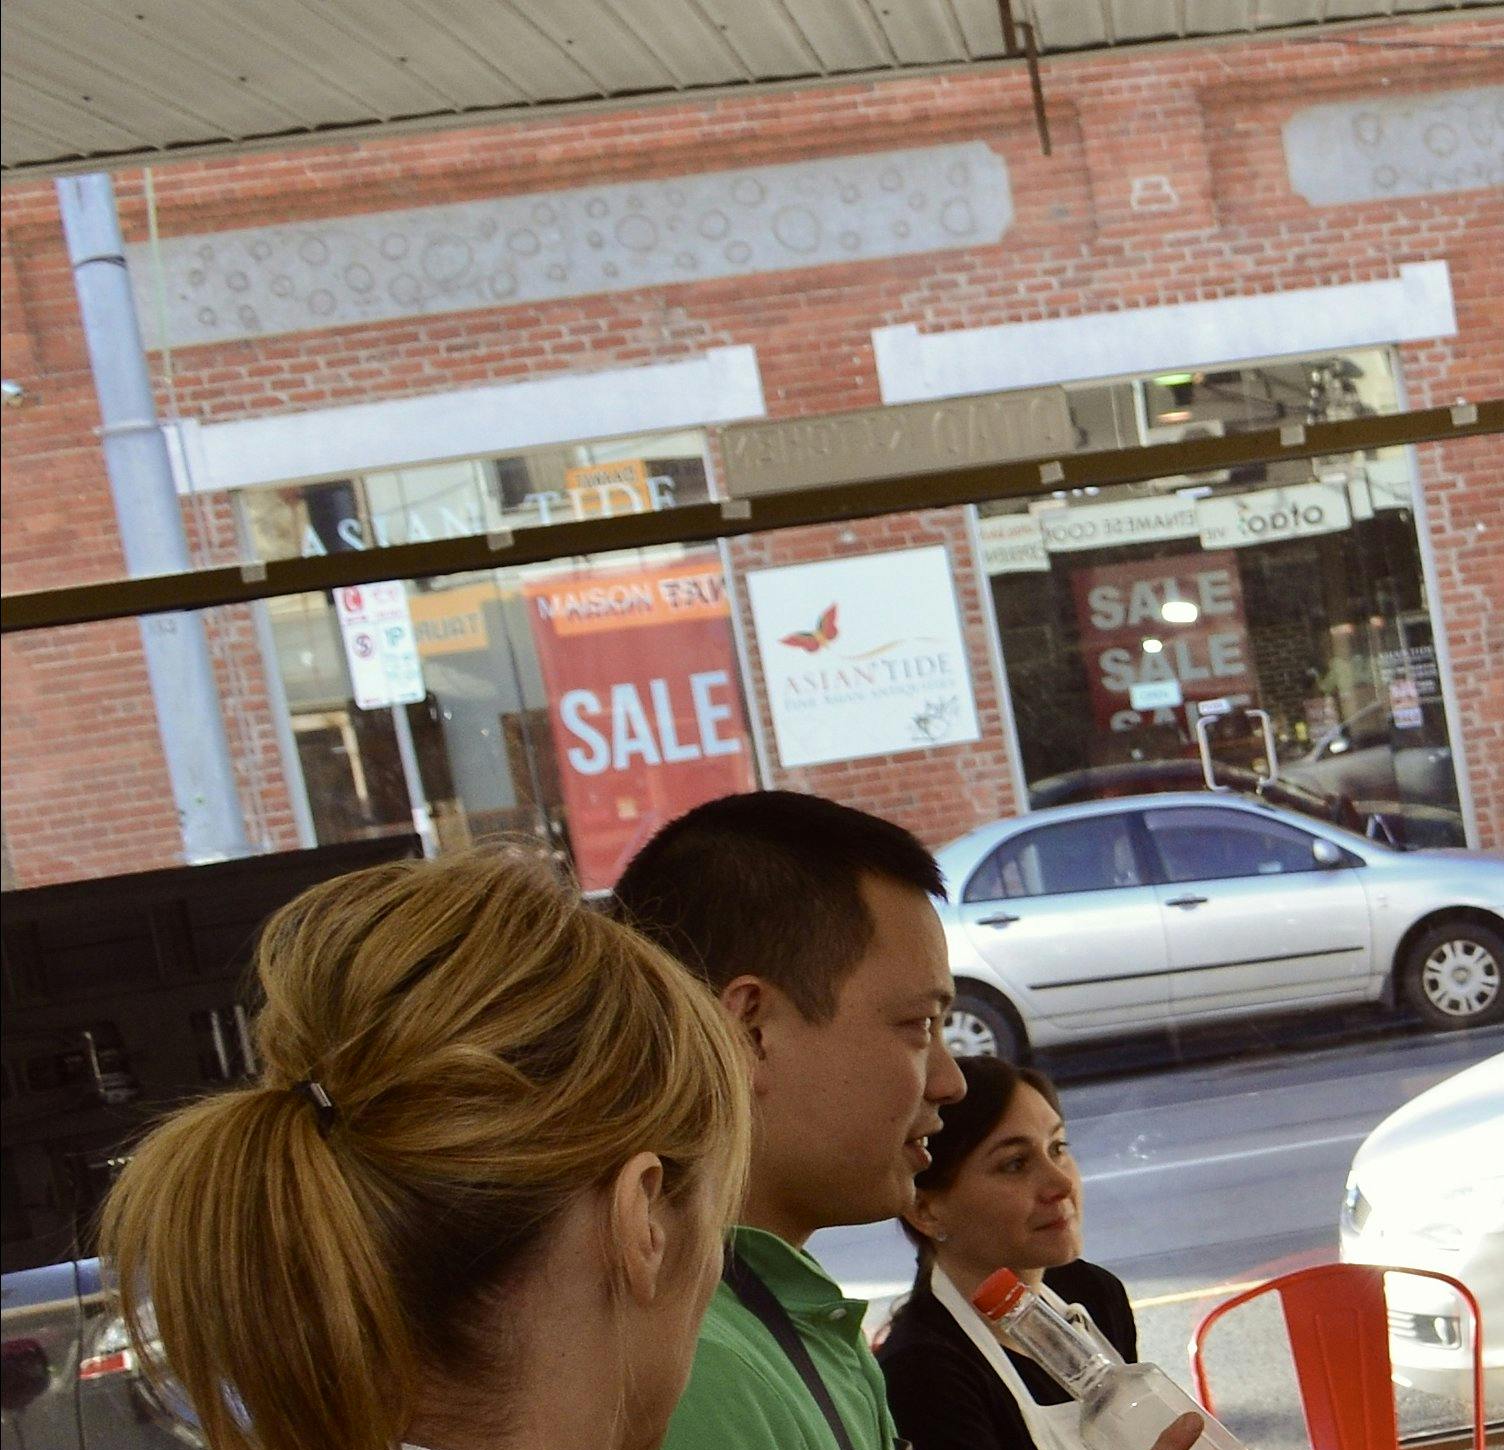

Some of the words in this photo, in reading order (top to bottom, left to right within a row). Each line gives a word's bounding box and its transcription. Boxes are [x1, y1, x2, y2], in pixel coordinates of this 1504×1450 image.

[1088, 569, 1235, 630] SALE
[786, 667, 877, 696] ASIAN
[880, 652, 954, 681] TIDE
[1099, 631, 1246, 692] SALE
[559, 669, 742, 777] SALE
